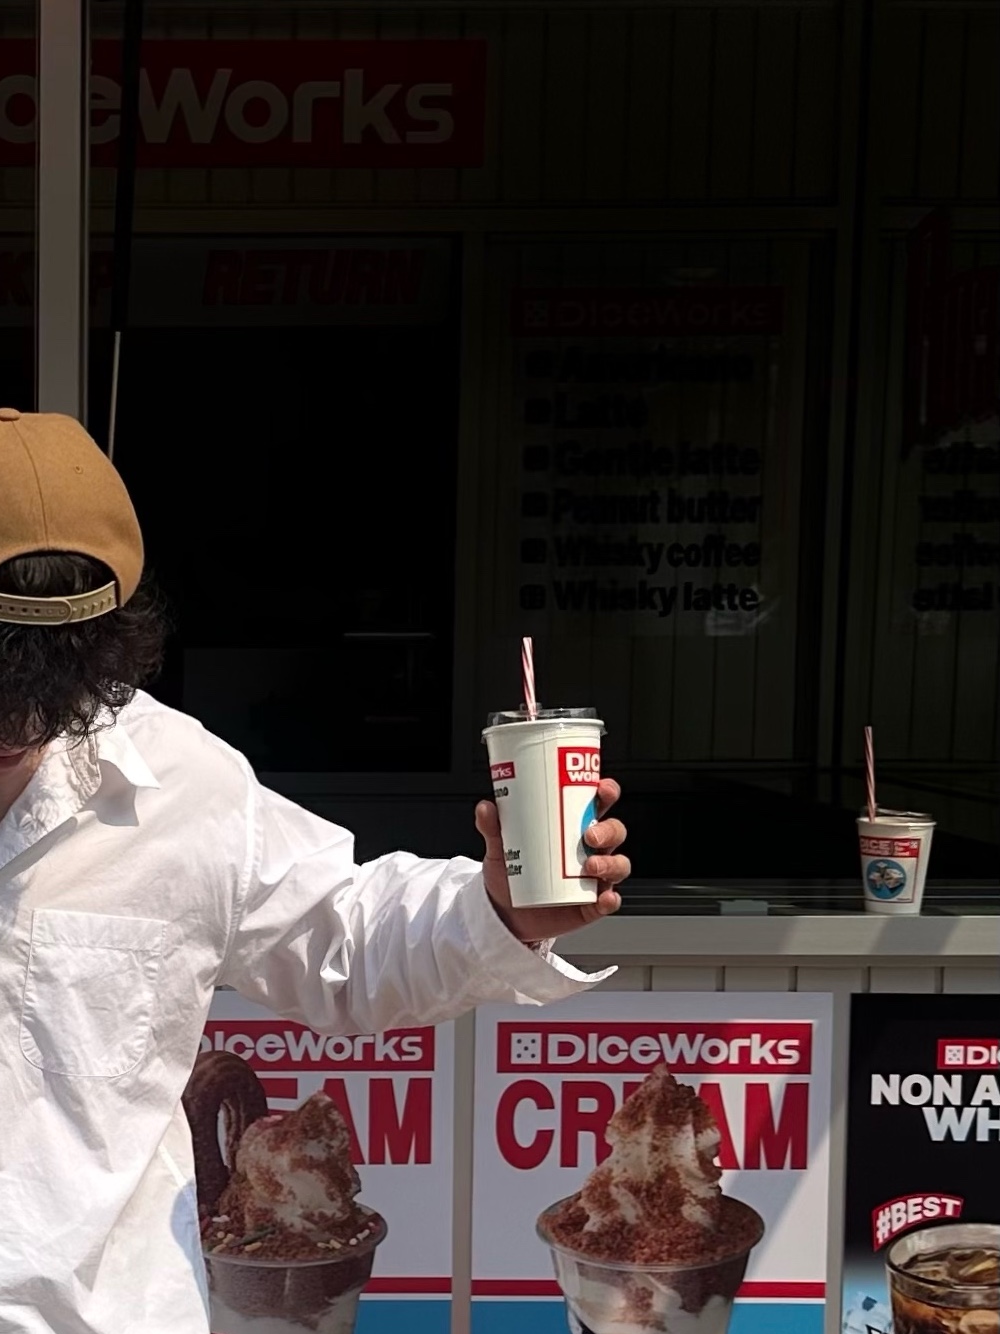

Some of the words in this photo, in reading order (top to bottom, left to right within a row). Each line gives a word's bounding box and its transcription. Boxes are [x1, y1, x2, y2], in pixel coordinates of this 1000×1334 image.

[202, 249, 426, 308] RETURN
[679, 441, 761, 476] latte
[666, 488, 761, 524] butter
[554, 537, 664, 574] Whisky
[666, 535, 761, 568] coffee
[554, 581, 676, 617] Whisky
[683, 581, 761, 612] latte
[966, 1046, 1000, 1066] DI
[870, 1074, 963, 1106] NON
[495, 1079, 810, 1171] CRAM
[875, 1197, 961, 1245] #BEST
